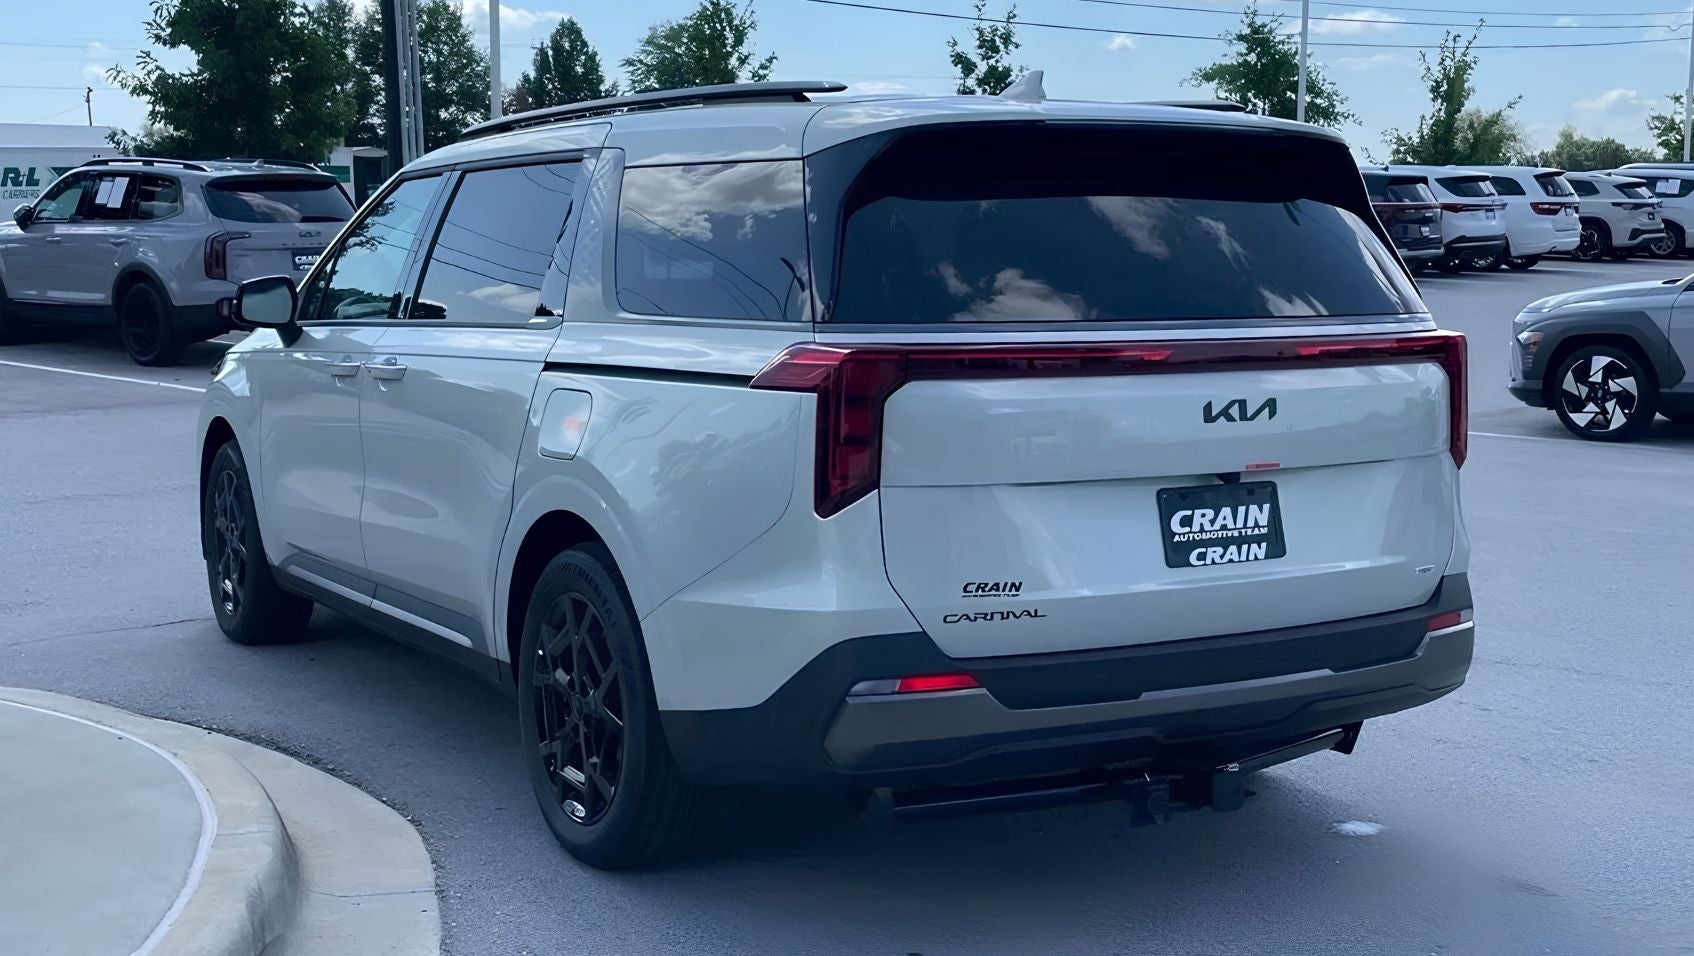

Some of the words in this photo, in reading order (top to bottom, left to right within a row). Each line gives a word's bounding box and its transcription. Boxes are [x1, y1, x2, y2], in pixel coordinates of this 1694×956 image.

[1202, 397, 1278, 424] KIA
[1170, 503, 1270, 534] CRAIN
[1189, 542, 1267, 566] CRAIN
[962, 581, 1023, 594] CRAIN
[943, 608, 1048, 624] CARNIVAL
